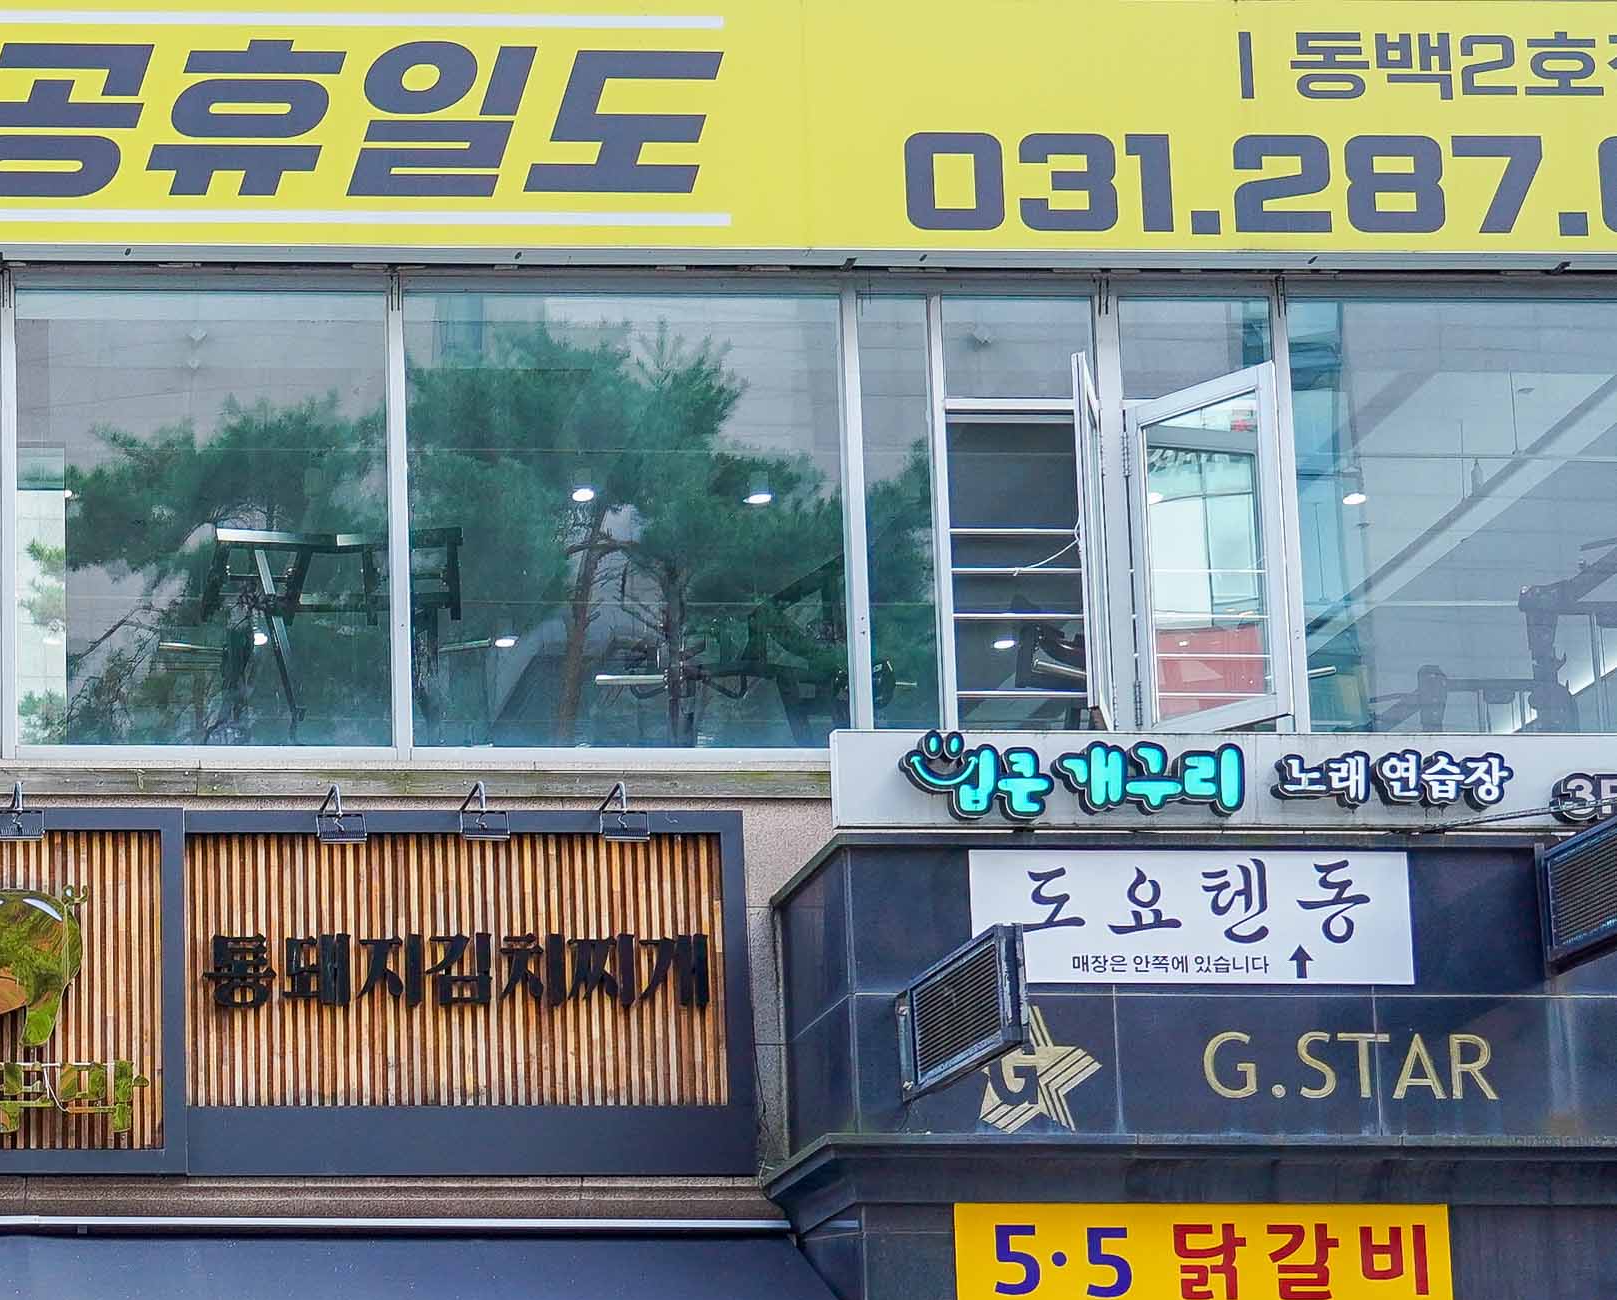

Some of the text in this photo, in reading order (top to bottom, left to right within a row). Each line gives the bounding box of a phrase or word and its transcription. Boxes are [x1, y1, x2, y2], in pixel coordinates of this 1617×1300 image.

[1289, 31, 1617, 100] 동백2호
[1053, 741, 1245, 814] 개구리
[1275, 752, 1371, 806] 노래
[1378, 751, 1514, 804] 연습장
[1020, 857, 1373, 944] 도요텐동
[202, 933, 711, 1009] 통돼지김치찌개
[1071, 953, 1270, 976] 매장은 안쪽에 있습니다
[1202, 1031, 1500, 1101] G.STAR
[1172, 1222, 1430, 1300] 닭갈비
